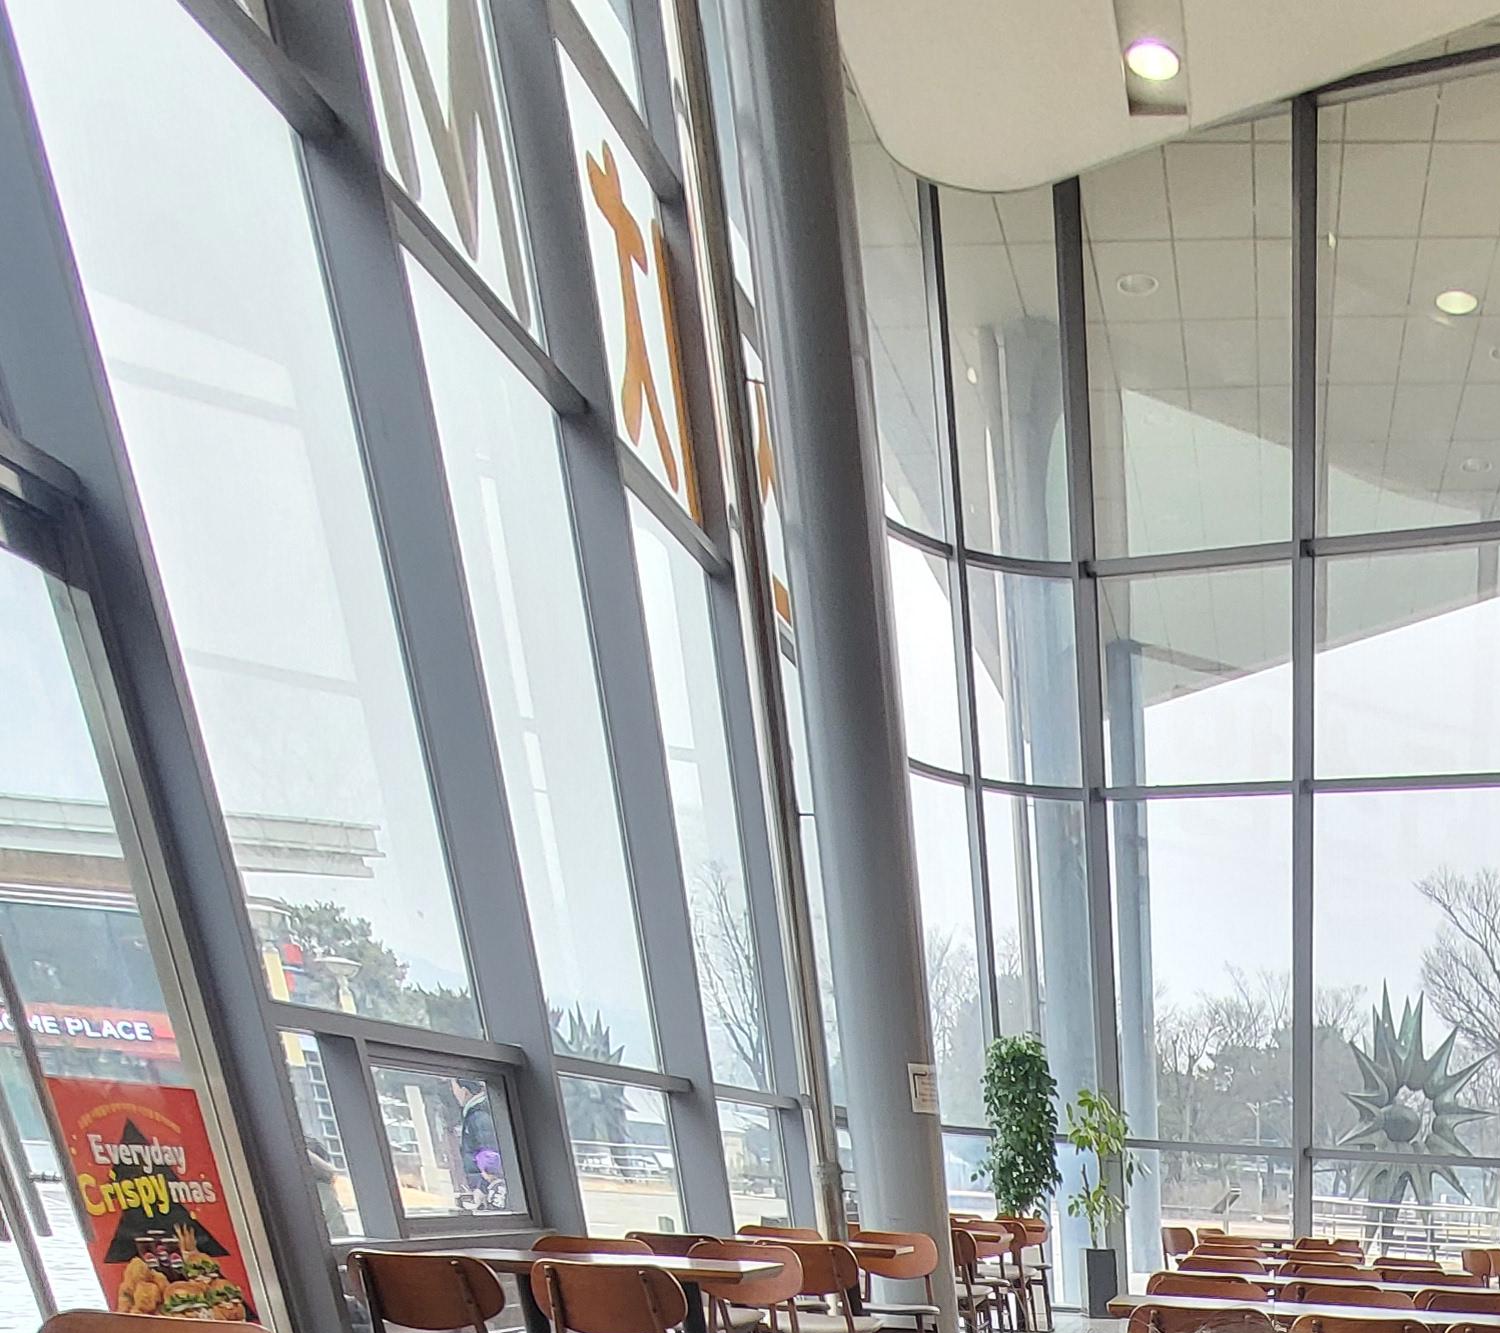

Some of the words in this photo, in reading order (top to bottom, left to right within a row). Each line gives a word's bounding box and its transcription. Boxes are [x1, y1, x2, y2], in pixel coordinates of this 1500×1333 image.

[0, 1010, 62, 1035] OME
[64, 1016, 153, 1042] PLACE
[87, 1133, 186, 1175] Everyday
[78, 1169, 217, 1218] Crispymas
